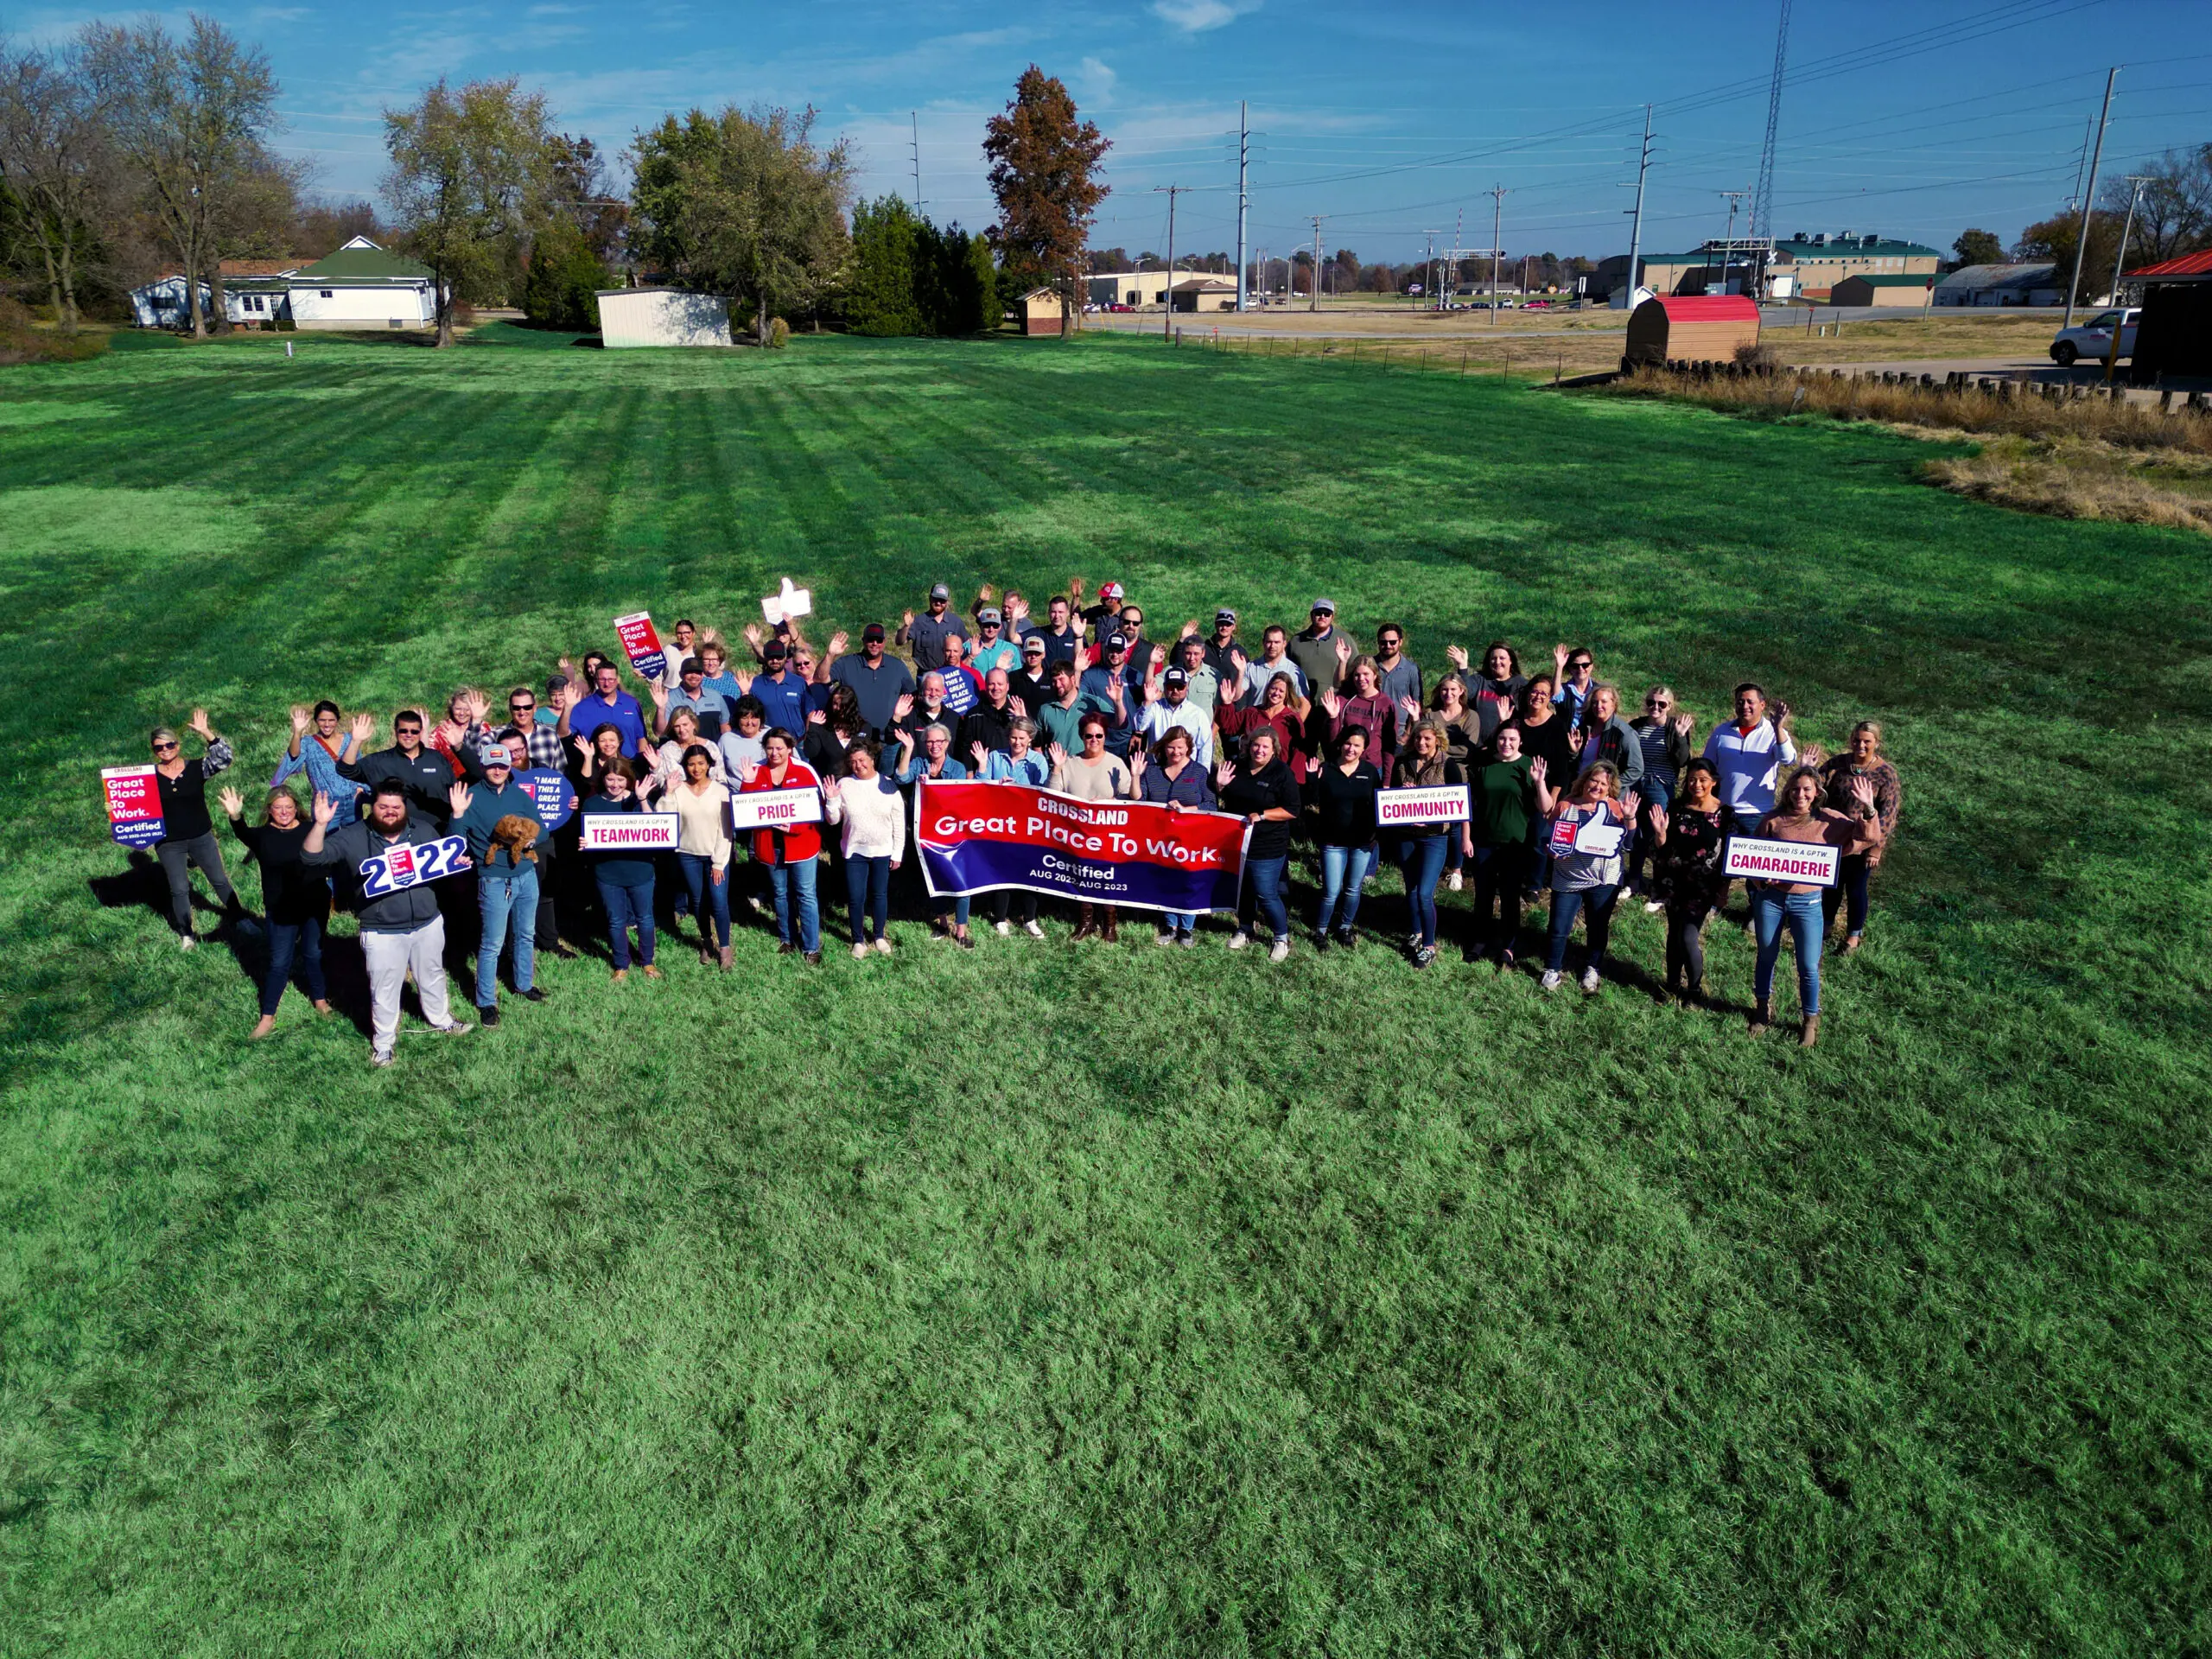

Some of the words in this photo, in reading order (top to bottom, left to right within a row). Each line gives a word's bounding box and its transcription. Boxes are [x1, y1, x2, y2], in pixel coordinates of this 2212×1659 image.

[620, 623, 645, 634] Great
[623, 632, 646, 642] Place
[634, 653, 663, 666] Certified
[944, 670, 960, 680] MAKE
[945, 678, 958, 686] THIS
[949, 682, 966, 693] GREAT
[951, 689, 969, 699] PLACE
[107, 779, 144, 789] Great
[110, 789, 145, 799] Place
[111, 800, 125, 809] To
[1382, 800, 1464, 818] COMMUNITY
[758, 803, 796, 820] PRIDE
[1038, 797, 1128, 825] CROSSLAND
[115, 821, 161, 833] Certified
[592, 828, 670, 843] TEAMWORK
[935, 816, 1016, 836] Great
[1027, 817, 1103, 851] Place
[1108, 833, 1138, 856] To
[1749, 844, 1789, 853] CROSSLAND
[1042, 855, 1114, 880] Certified
[1731, 854, 1831, 877] CAMARADERIE
[1030, 869, 1052, 879] AUG
